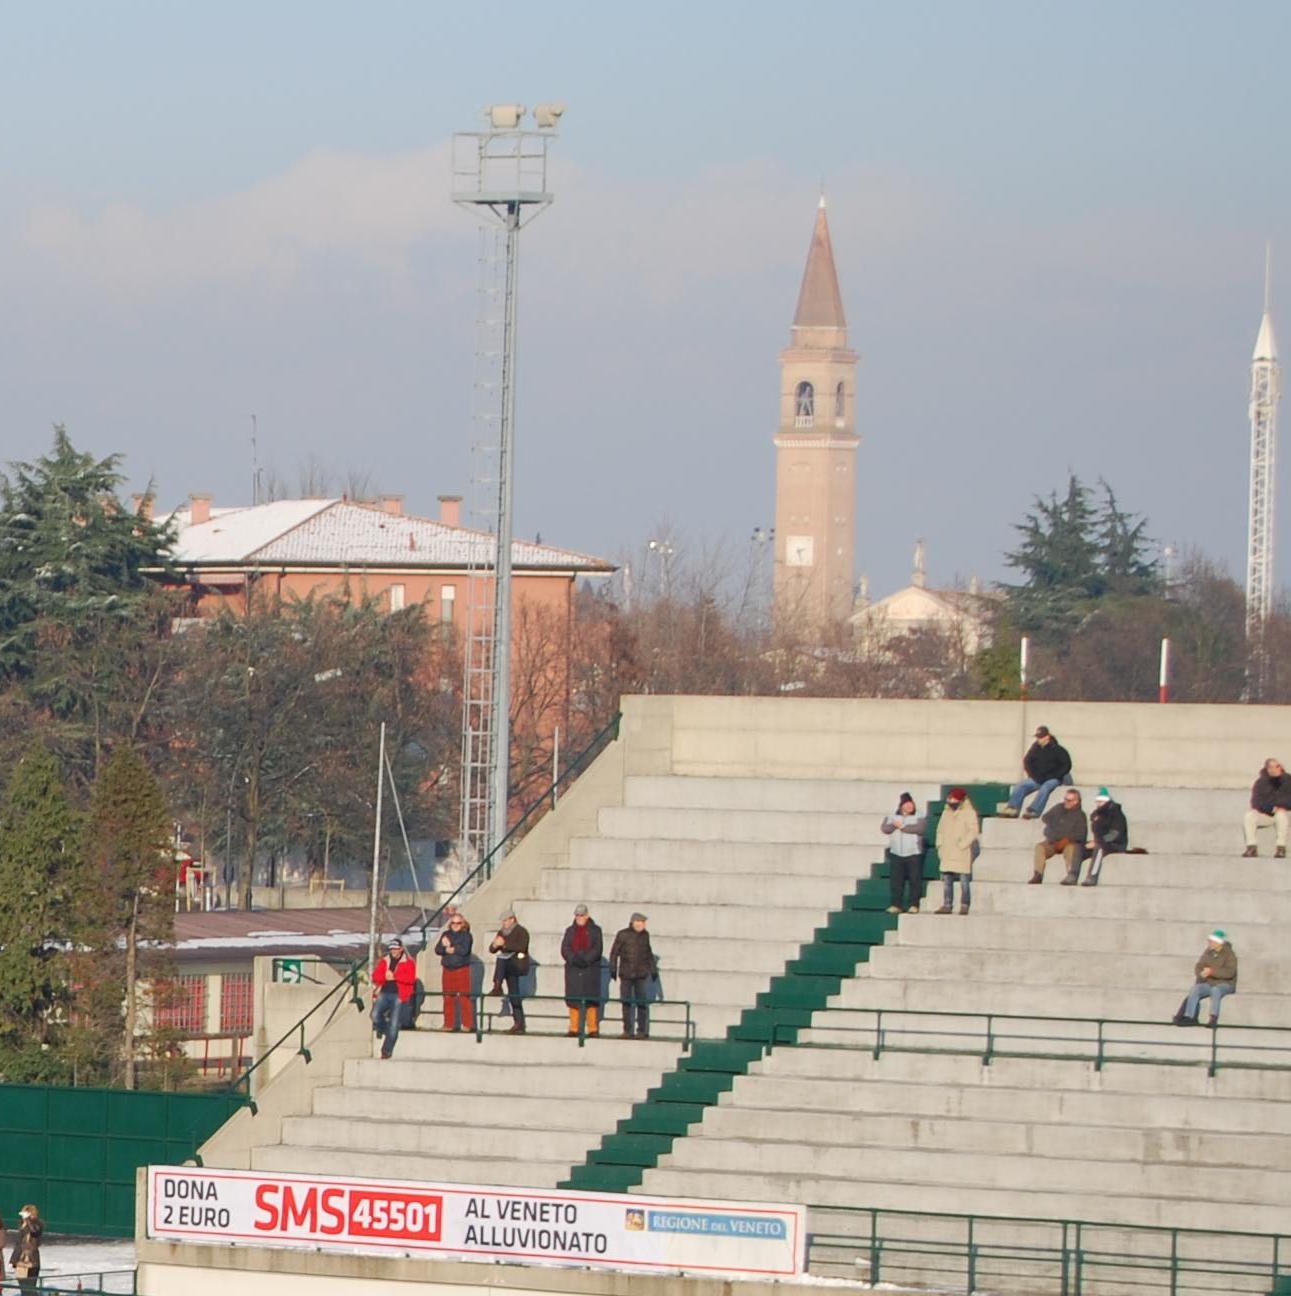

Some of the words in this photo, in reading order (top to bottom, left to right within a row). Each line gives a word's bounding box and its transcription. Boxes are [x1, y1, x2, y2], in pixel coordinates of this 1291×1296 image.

[163, 1179, 218, 1201] DONA
[163, 1206, 174, 1225] 2
[179, 1206, 231, 1228] EURO
[253, 1184, 346, 1235] SMS
[352, 1198, 438, 1233] 45501
[465, 1198, 491, 1219] AL
[497, 1199, 578, 1224] VENETO
[652, 1214, 708, 1231] REGIONE
[729, 1219, 782, 1235] VENETO
[464, 1225, 608, 1254] ALLUVIONATO
